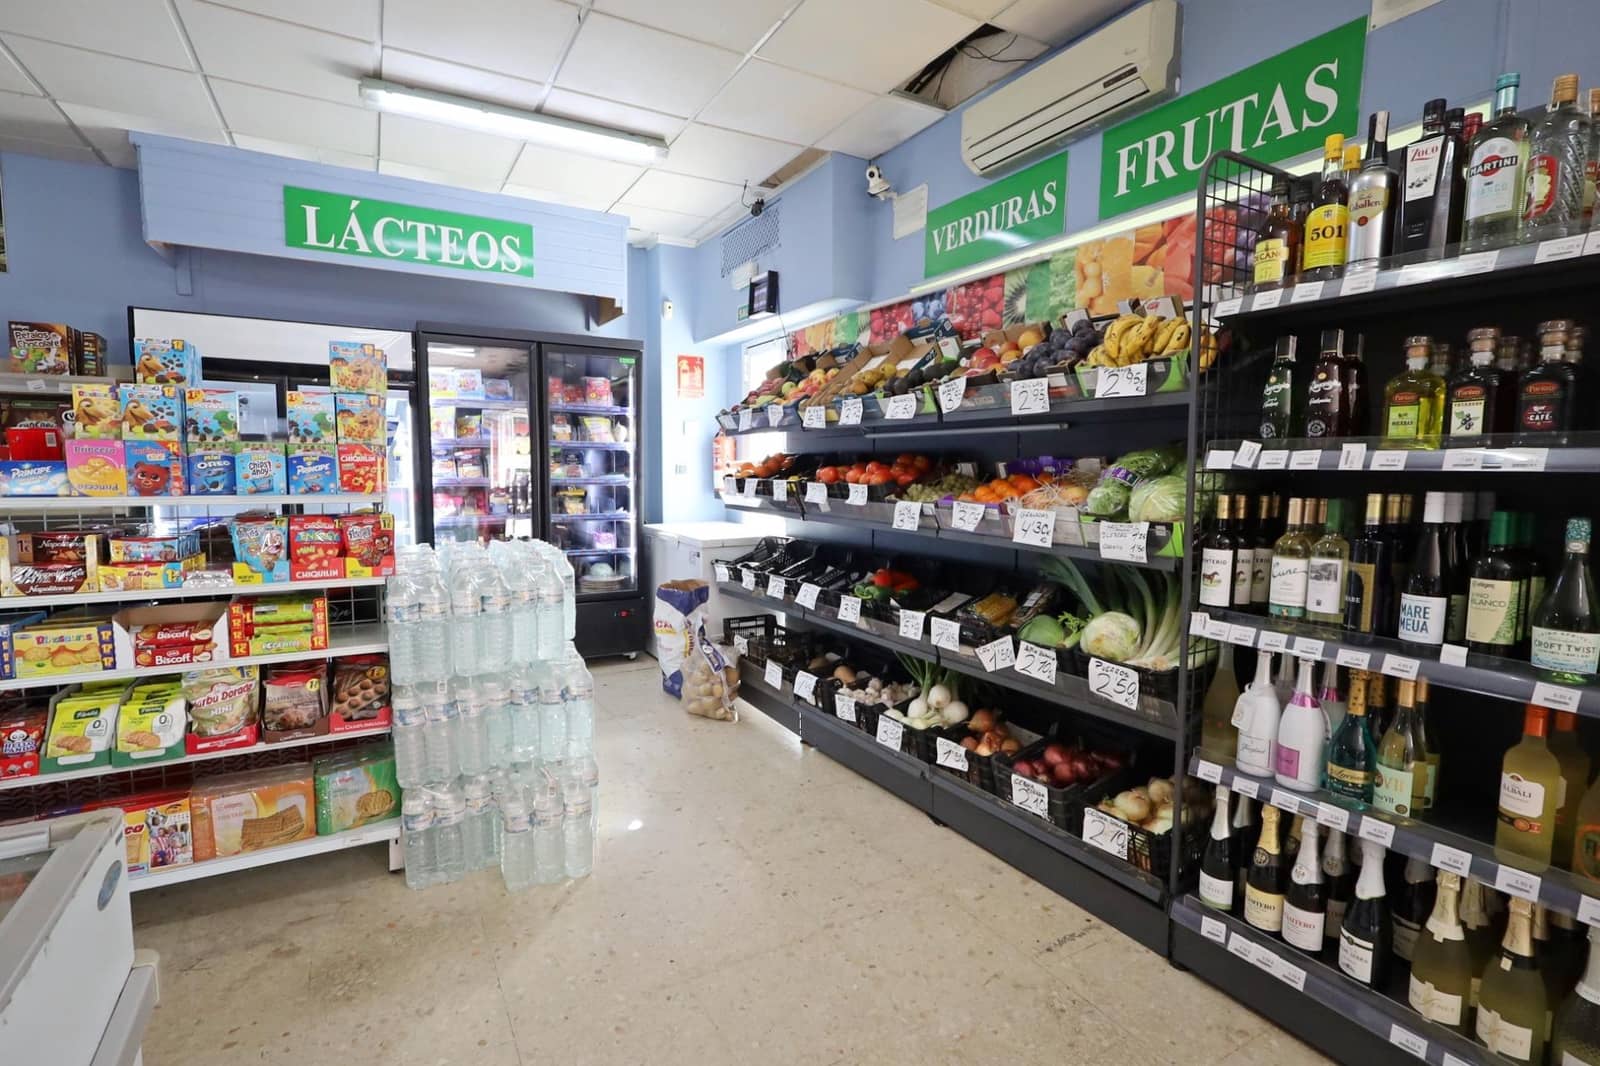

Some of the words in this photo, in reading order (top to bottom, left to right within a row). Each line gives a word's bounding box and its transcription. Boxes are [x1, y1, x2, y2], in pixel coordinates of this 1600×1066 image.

[1114, 58, 1338, 197] FRUTAS
[1410, 144, 1439, 161] Zoco
[1471, 156, 1517, 176] MARTINI
[931, 180, 1057, 256] VERDURAS
[301, 200, 522, 273] LÁCTEOS
[1310, 225, 1344, 241] 501
[197, 461, 231, 469] OREO
[296, 570, 339, 578] CHIQUILIN
[1400, 603, 1431, 619] MARE
[1399, 617, 1429, 634] MEUA
[157, 630, 189, 640] Biscoff
[1568, 643, 1596, 654] TWIST
[155, 654, 190, 665] Biscoff
